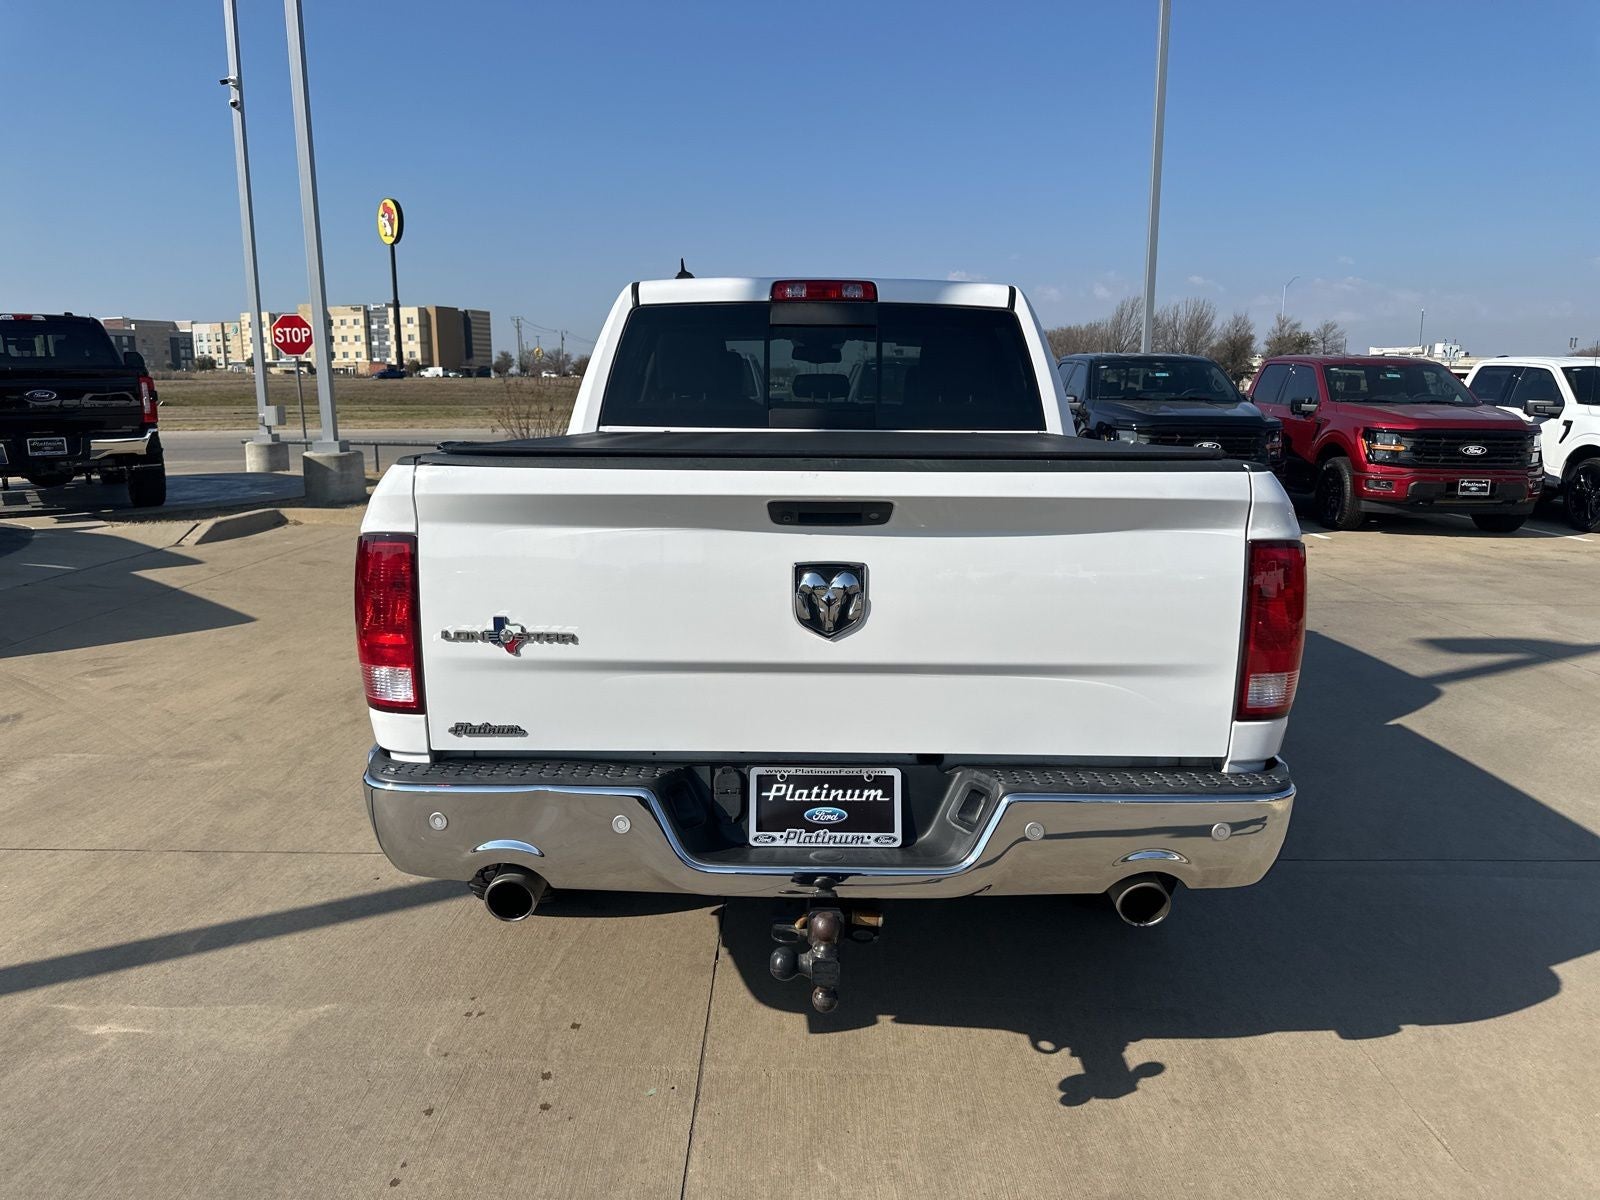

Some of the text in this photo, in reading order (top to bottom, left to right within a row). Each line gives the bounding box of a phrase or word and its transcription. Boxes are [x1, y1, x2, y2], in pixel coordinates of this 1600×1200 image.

[275, 327, 310, 343] STOP
[441, 629, 501, 643] LONE
[448, 722, 529, 737] Platinum
[761, 783, 891, 801] Platinum
[784, 829, 871, 845] Platinum
